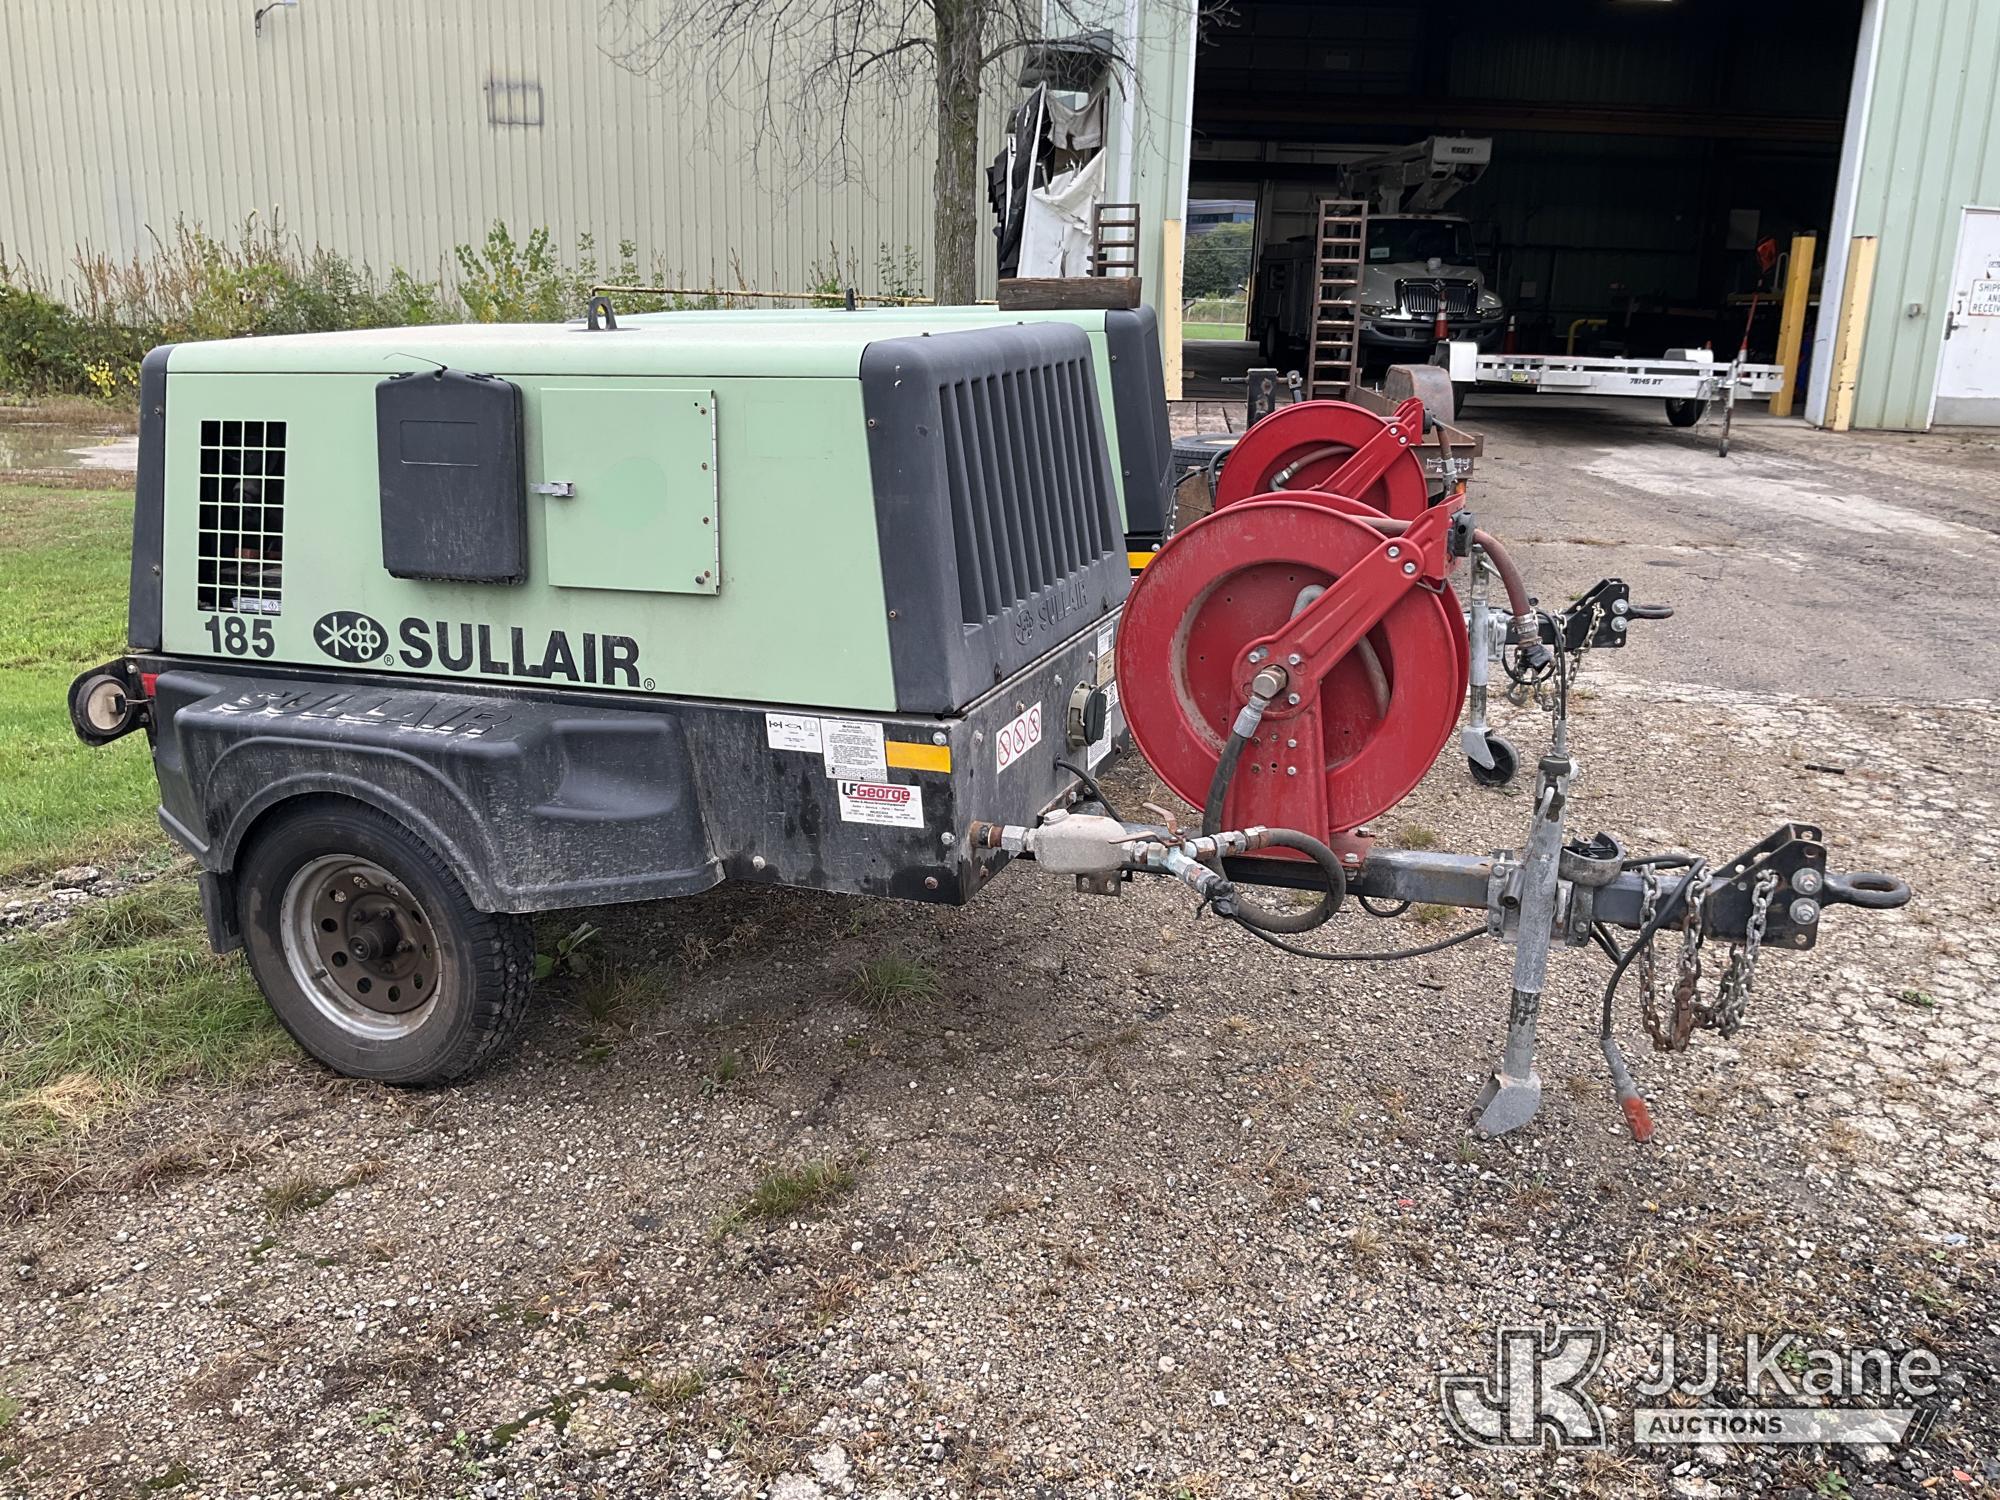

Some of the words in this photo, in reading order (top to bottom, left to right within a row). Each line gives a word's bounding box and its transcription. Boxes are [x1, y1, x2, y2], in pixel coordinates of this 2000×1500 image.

[1037, 579, 1089, 632] SULLAIR
[204, 615, 276, 658] 185
[398, 616, 641, 688] SULLAIR
[208, 691, 515, 736] SULLAIR
